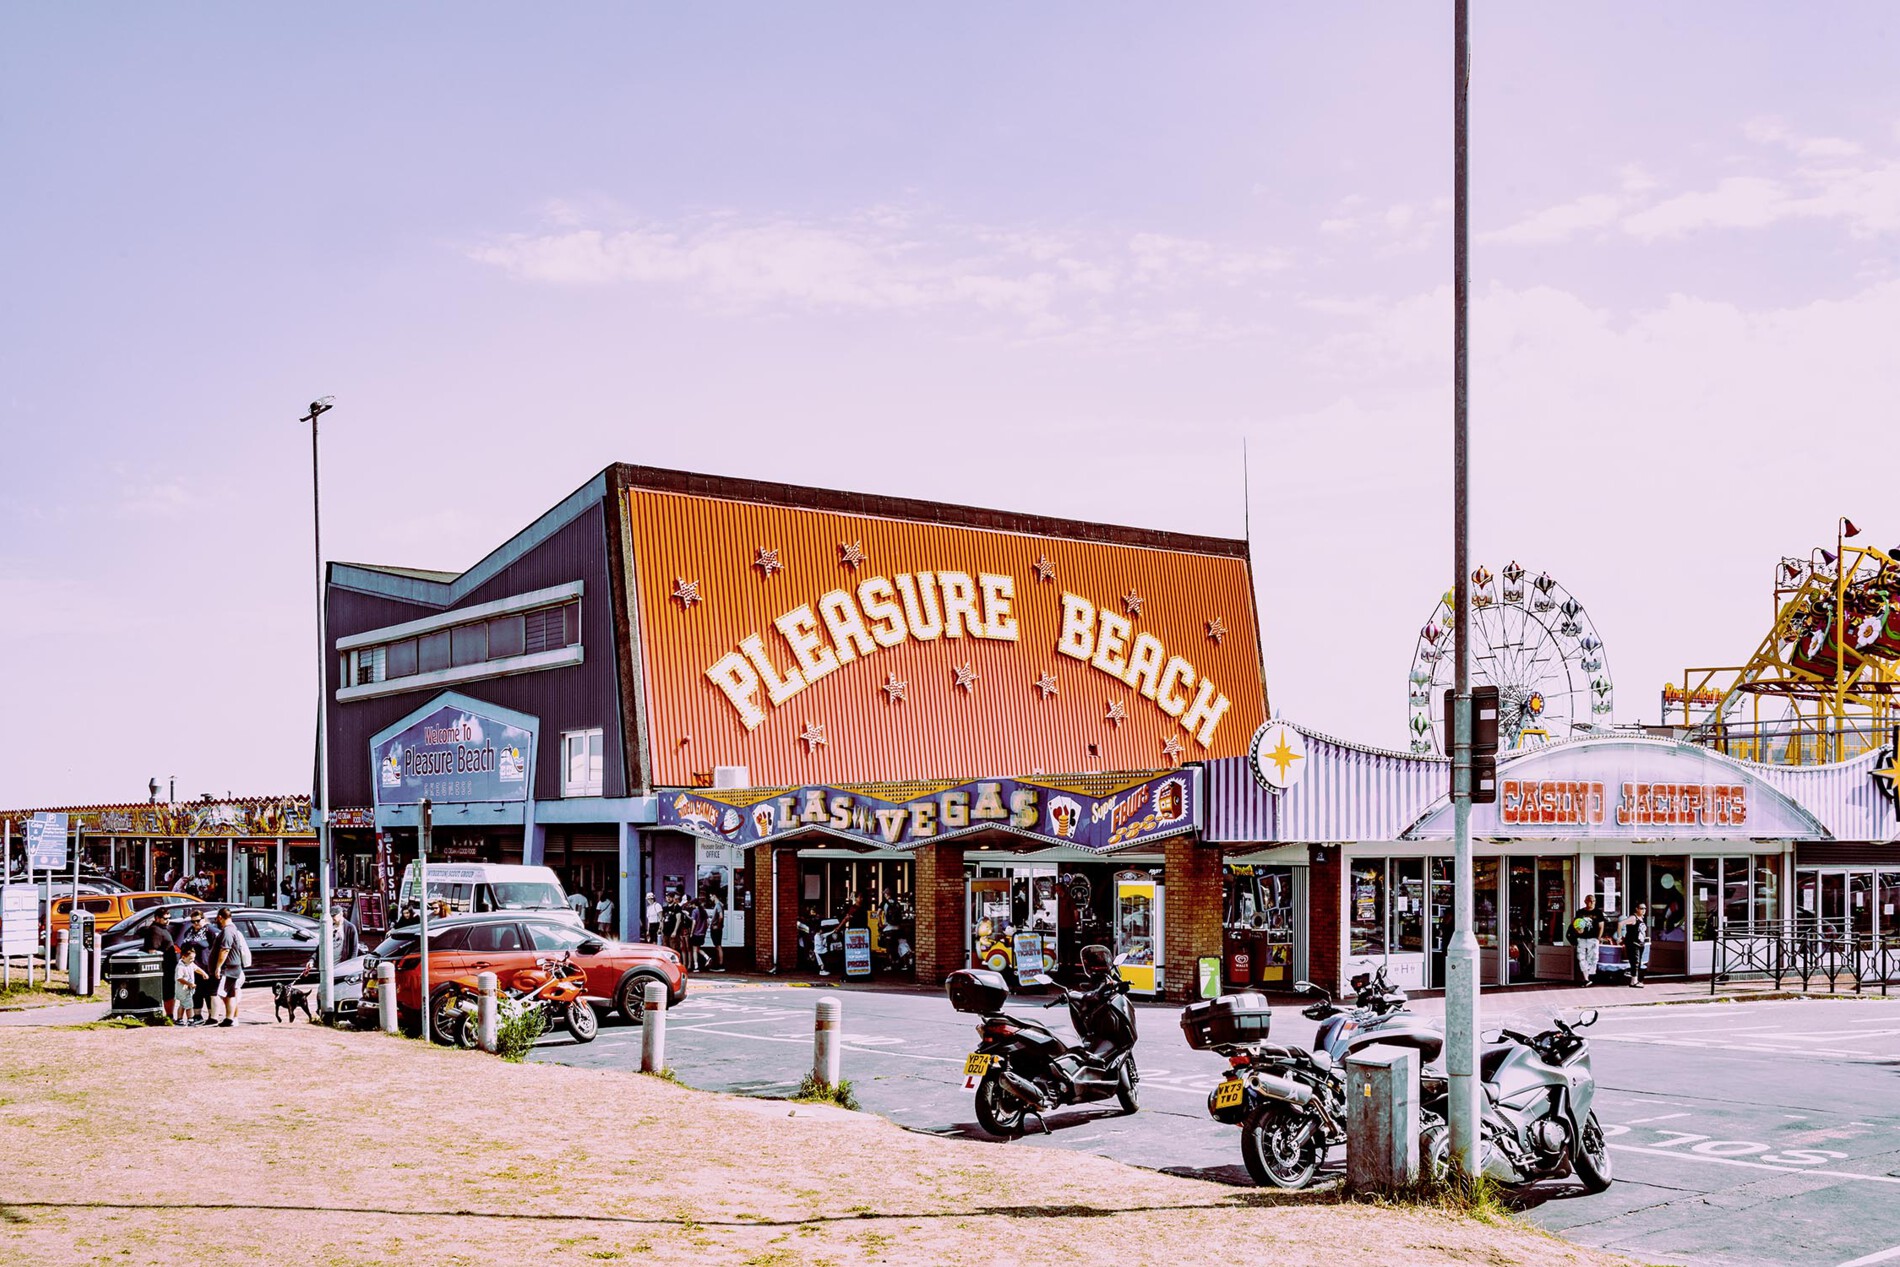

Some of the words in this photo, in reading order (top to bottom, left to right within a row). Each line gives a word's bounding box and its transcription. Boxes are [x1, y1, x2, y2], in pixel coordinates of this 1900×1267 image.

[704, 570, 1020, 732] PLEASURE
[1057, 590, 1231, 749] BEACH
[425, 723, 460, 745] Welcome
[462, 724, 472, 741] To
[405, 745, 453, 776] Pleasure
[457, 738, 495, 773] Beach
[696, 800, 719, 827] GAMES
[778, 790, 852, 829] LAS
[876, 782, 1039, 842] VEGAS
[1092, 795, 1117, 824] Super
[1111, 784, 1150, 834] FRUITS
[1501, 780, 1606, 825] CASINO
[1617, 781, 1747, 826] JACKPOTS
[385, 844, 396, 900] SLUSH
[969, 1055, 989, 1064] YP74
[965, 1076, 975, 1089] L
